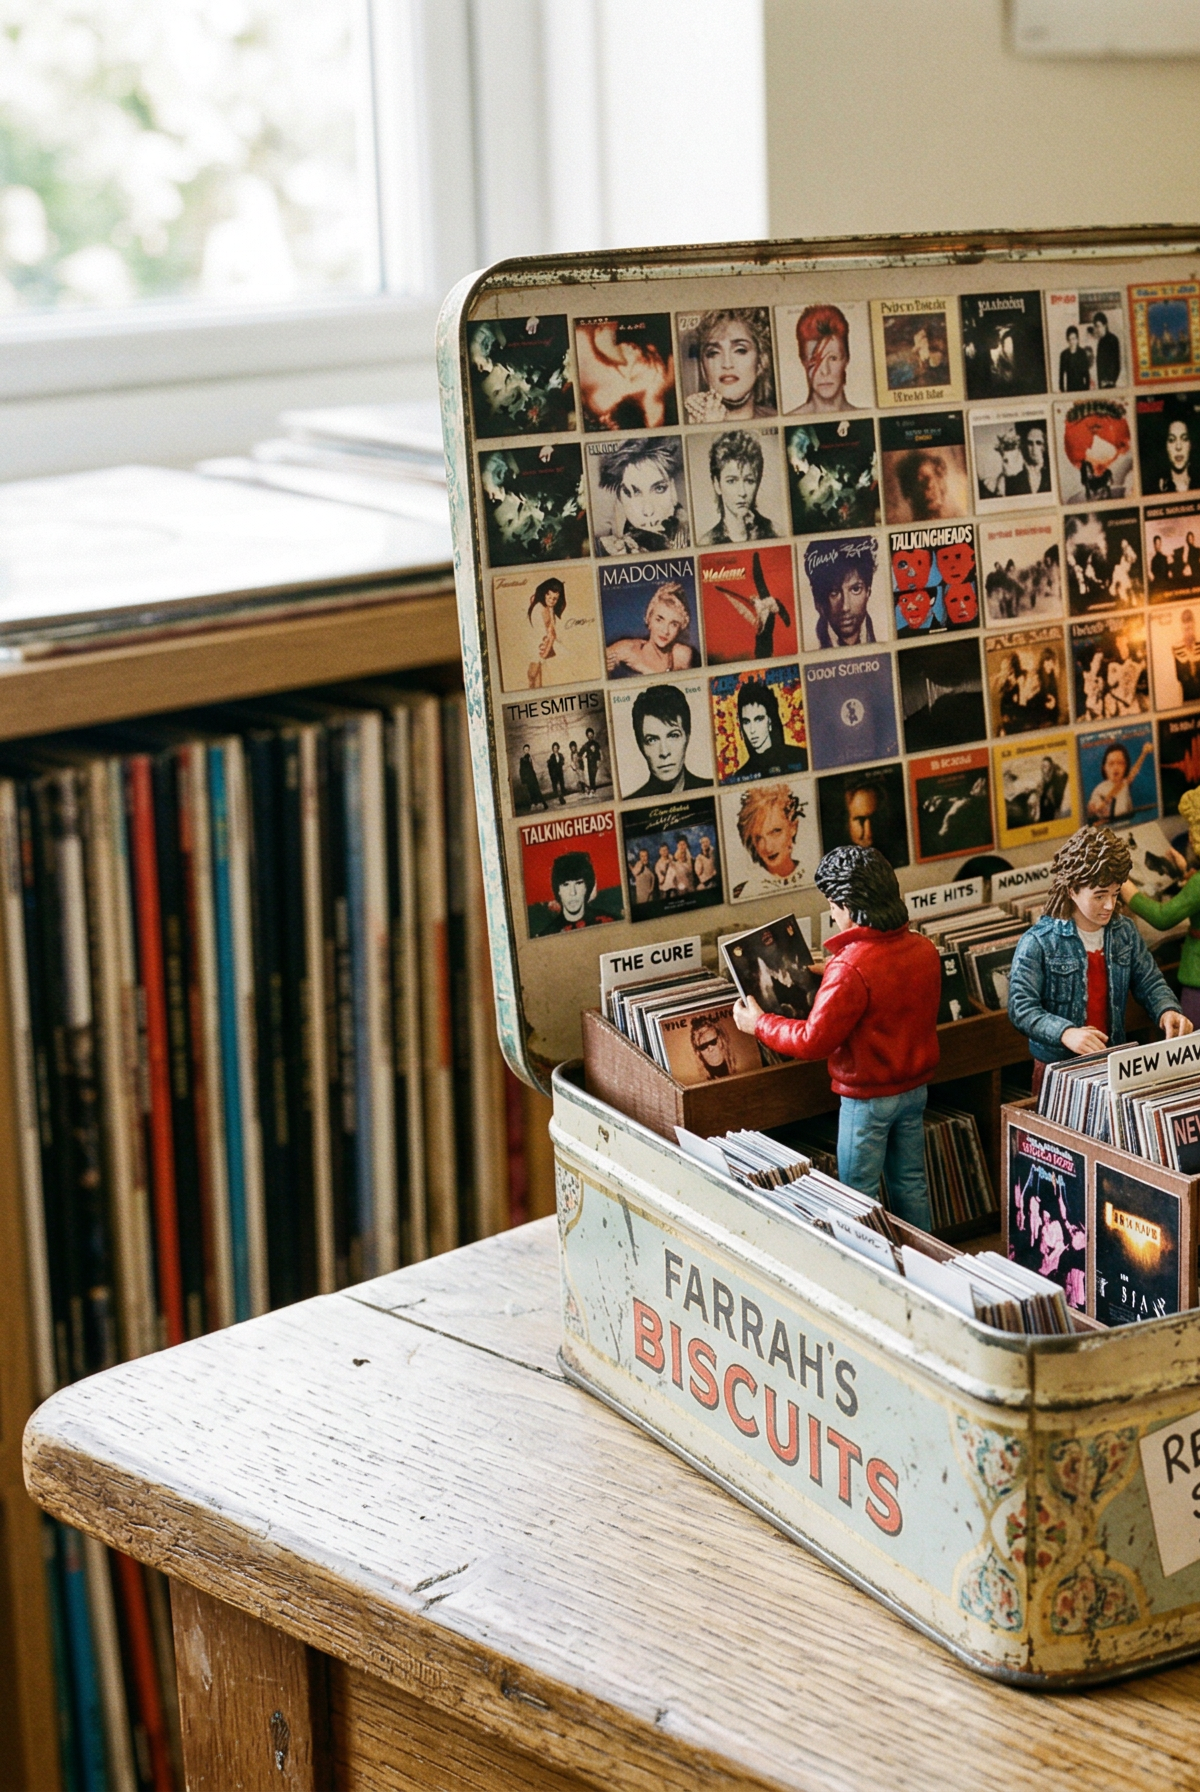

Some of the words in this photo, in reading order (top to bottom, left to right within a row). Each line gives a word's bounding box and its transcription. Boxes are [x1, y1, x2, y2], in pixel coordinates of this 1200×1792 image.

[603, 560, 693, 586] MADONNA
[507, 702, 539, 720] THE
[911, 892, 937, 909] THE
[610, 954, 645, 974] THE
[650, 943, 694, 964] CURE
[1118, 1053, 1161, 1081] NEW
[664, 1247, 859, 1418] FARRAH'S
[632, 1296, 903, 1537] BISCUITS
